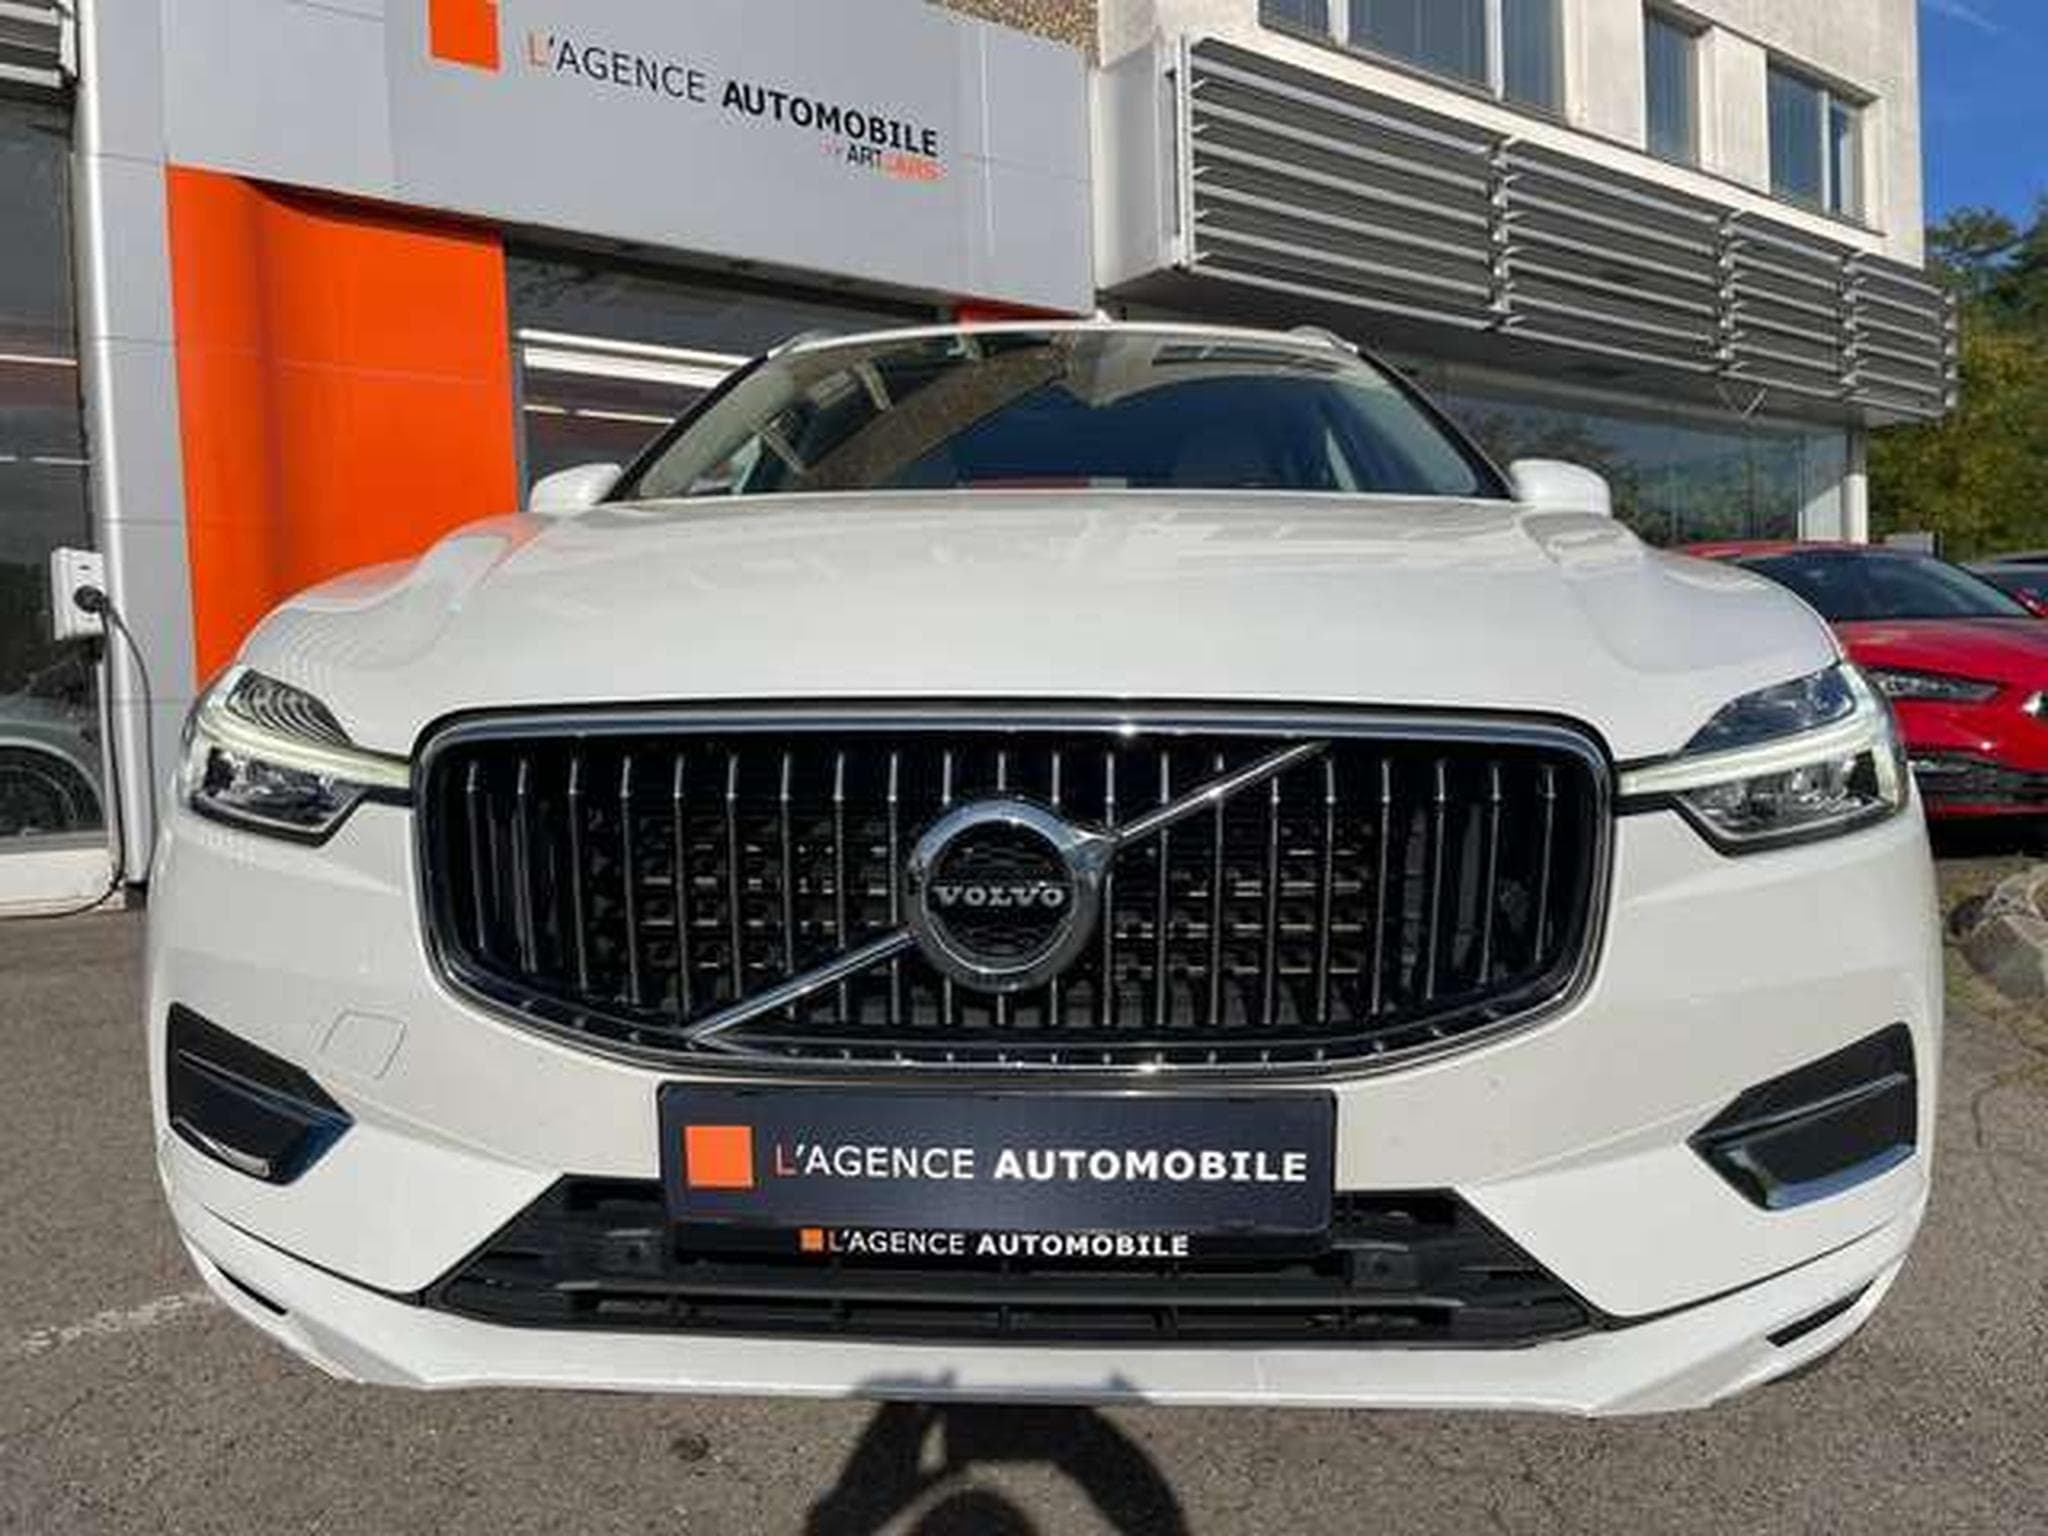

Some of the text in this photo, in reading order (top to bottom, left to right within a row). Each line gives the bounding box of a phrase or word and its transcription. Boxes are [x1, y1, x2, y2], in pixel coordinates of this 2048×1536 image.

[528, 33, 939, 157] L'AGENCE AUTOMOBILE
[932, 884, 1063, 907] VOLVO
[775, 1145, 1308, 1182] L'AGENCE AUTOMOBILE
[829, 1230, 1190, 1257] L'AGENCE AUTOMOBILE
